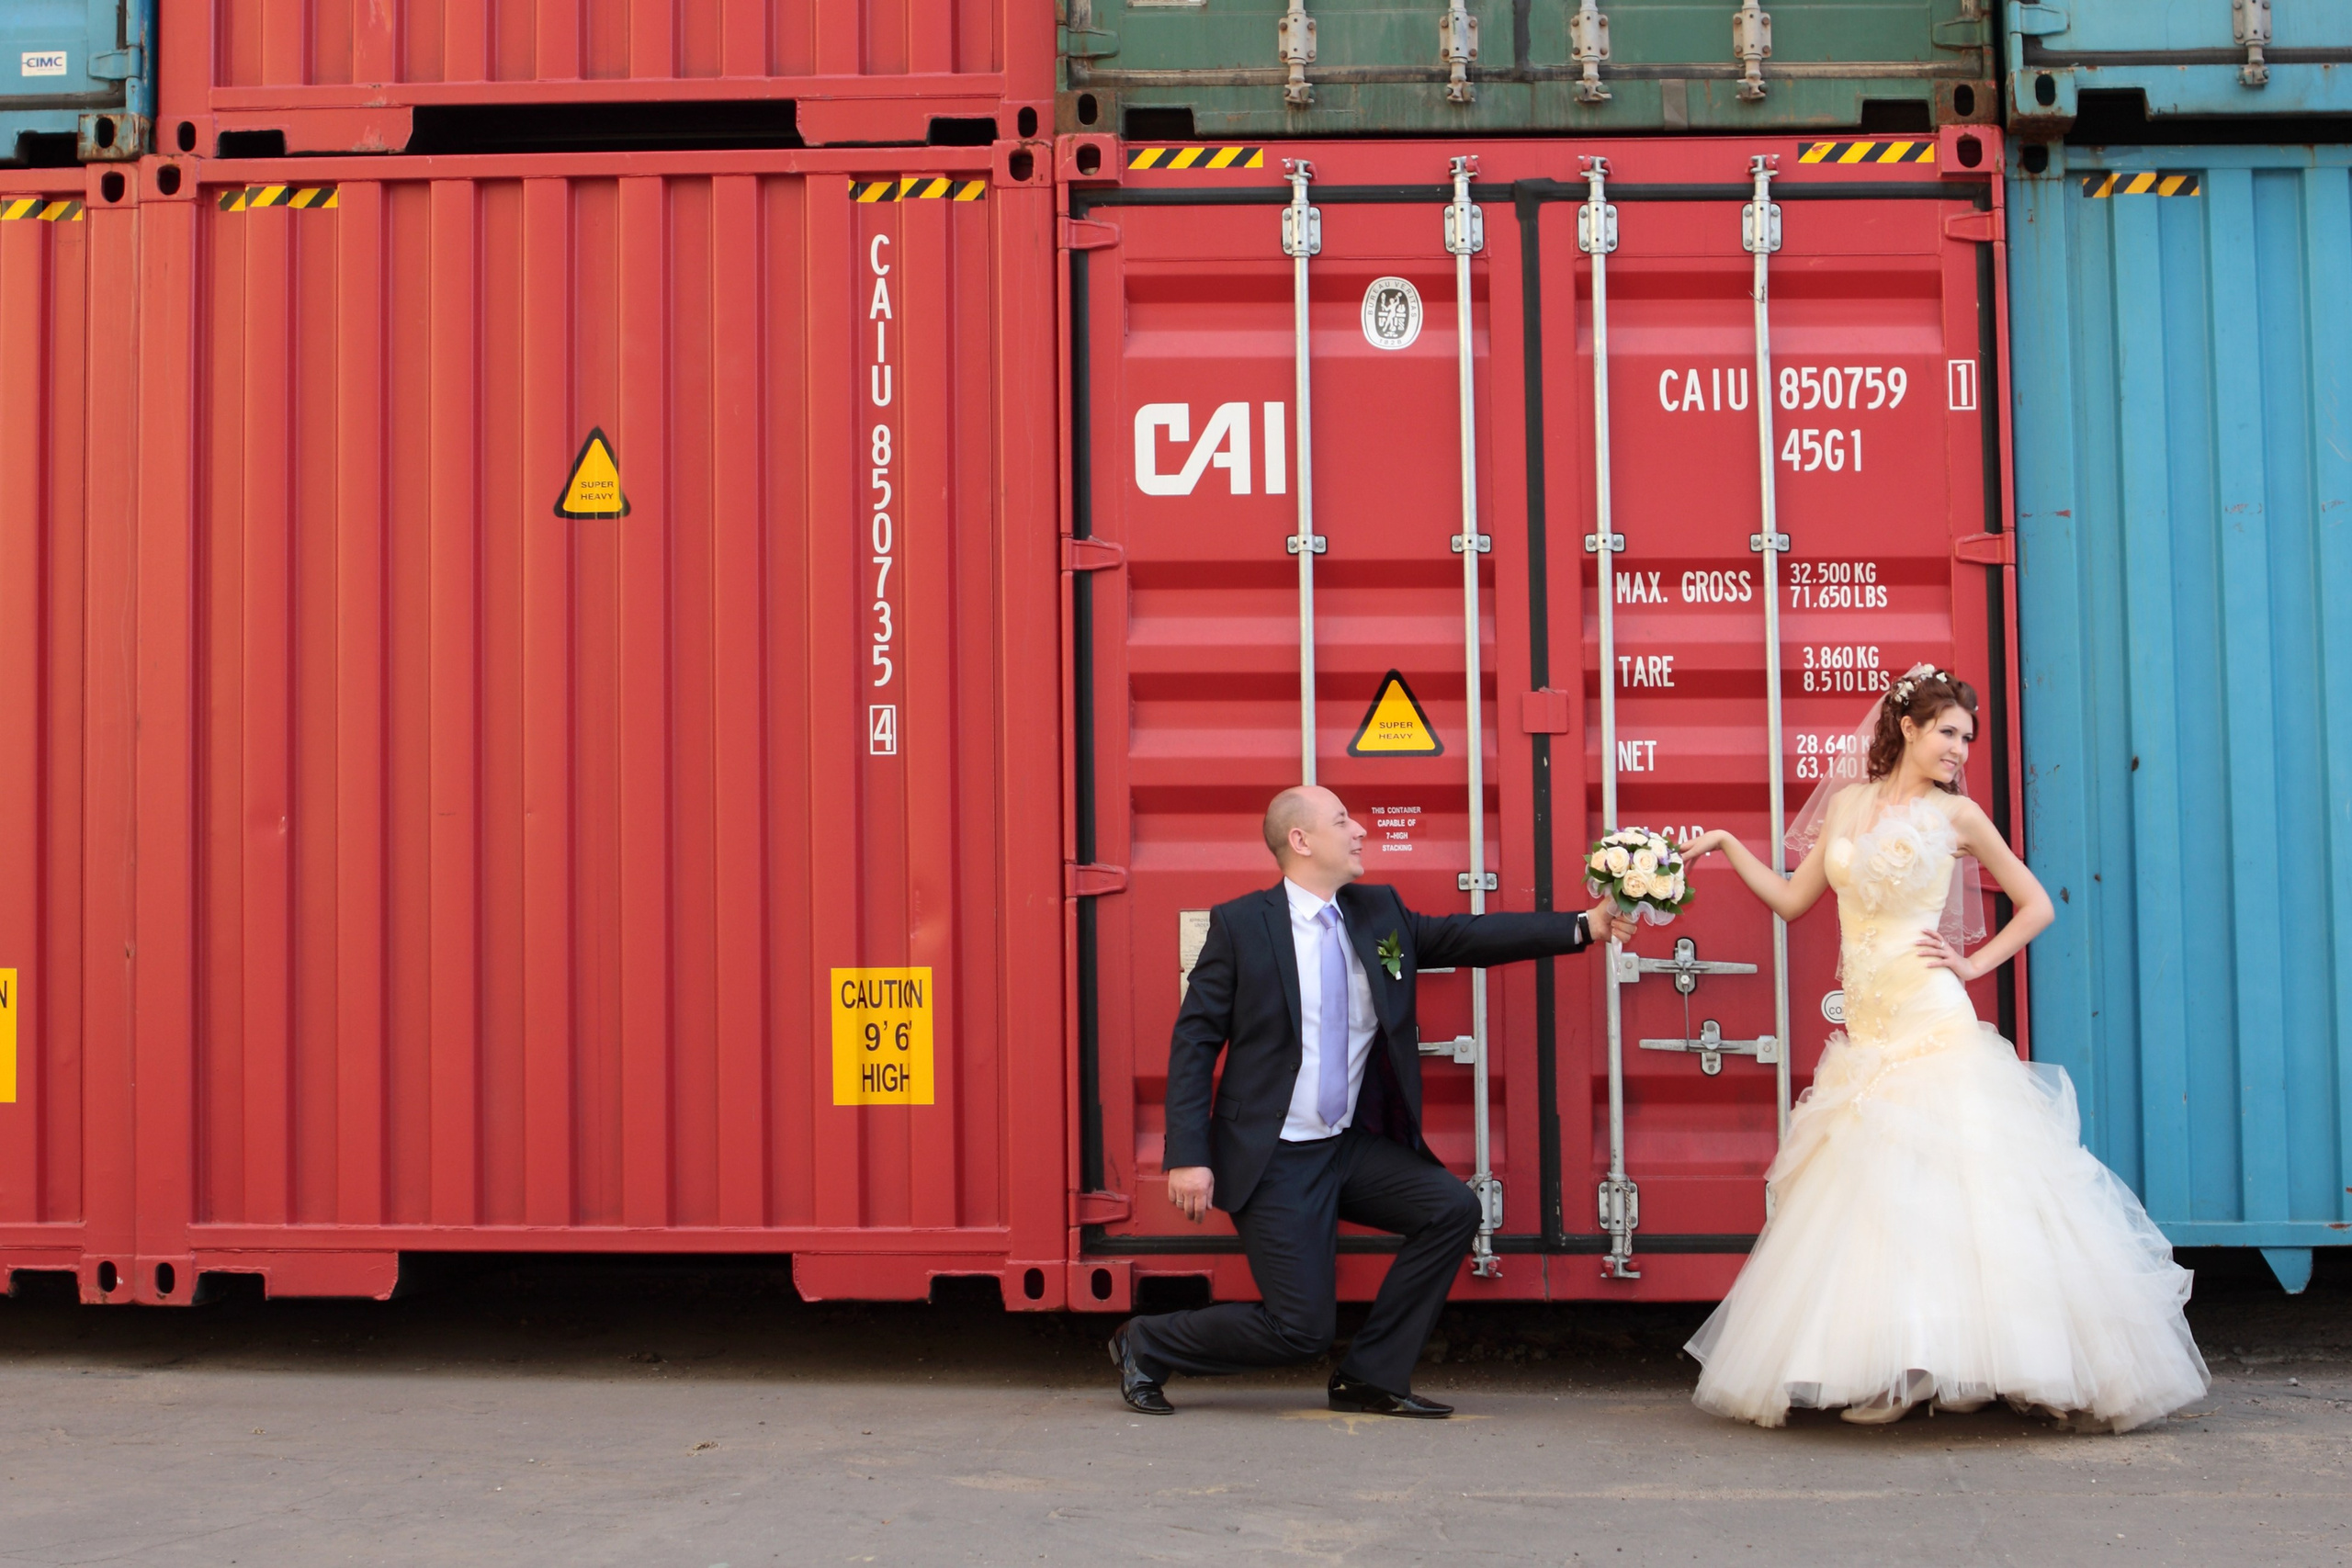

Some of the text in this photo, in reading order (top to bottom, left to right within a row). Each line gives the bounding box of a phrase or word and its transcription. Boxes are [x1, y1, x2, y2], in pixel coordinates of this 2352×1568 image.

[24, 56, 63, 68] CIMC
[1367, 281, 1417, 318] BUREAU VERITAS
[1658, 367, 1749, 412] CAIU
[1779, 367, 1908, 410] 850759
[1134, 401, 1286, 496] CAI
[1781, 428, 1862, 472] 45G1
[580, 492, 614, 501] HEAVY
[869, 233, 894, 752] CAIU 850735 4
[1854, 562, 1877, 583] KG
[1616, 570, 1753, 604] MAX. GROSS
[1854, 584, 1888, 608] LBS
[1856, 646, 1880, 669] KG
[1618, 655, 1675, 687] TARE
[1857, 670, 1891, 692] LBS
[1379, 721, 1414, 729] SUPER
[1618, 740, 1657, 772] NET
[1386, 806, 1422, 814] CONTAINER
[1377, 818, 1416, 827] CAPABLE OF
[1385, 831, 1408, 840] 7-HIGH
[1382, 843, 1413, 852] STACKING
[862, 1063, 910, 1092] HIGH
